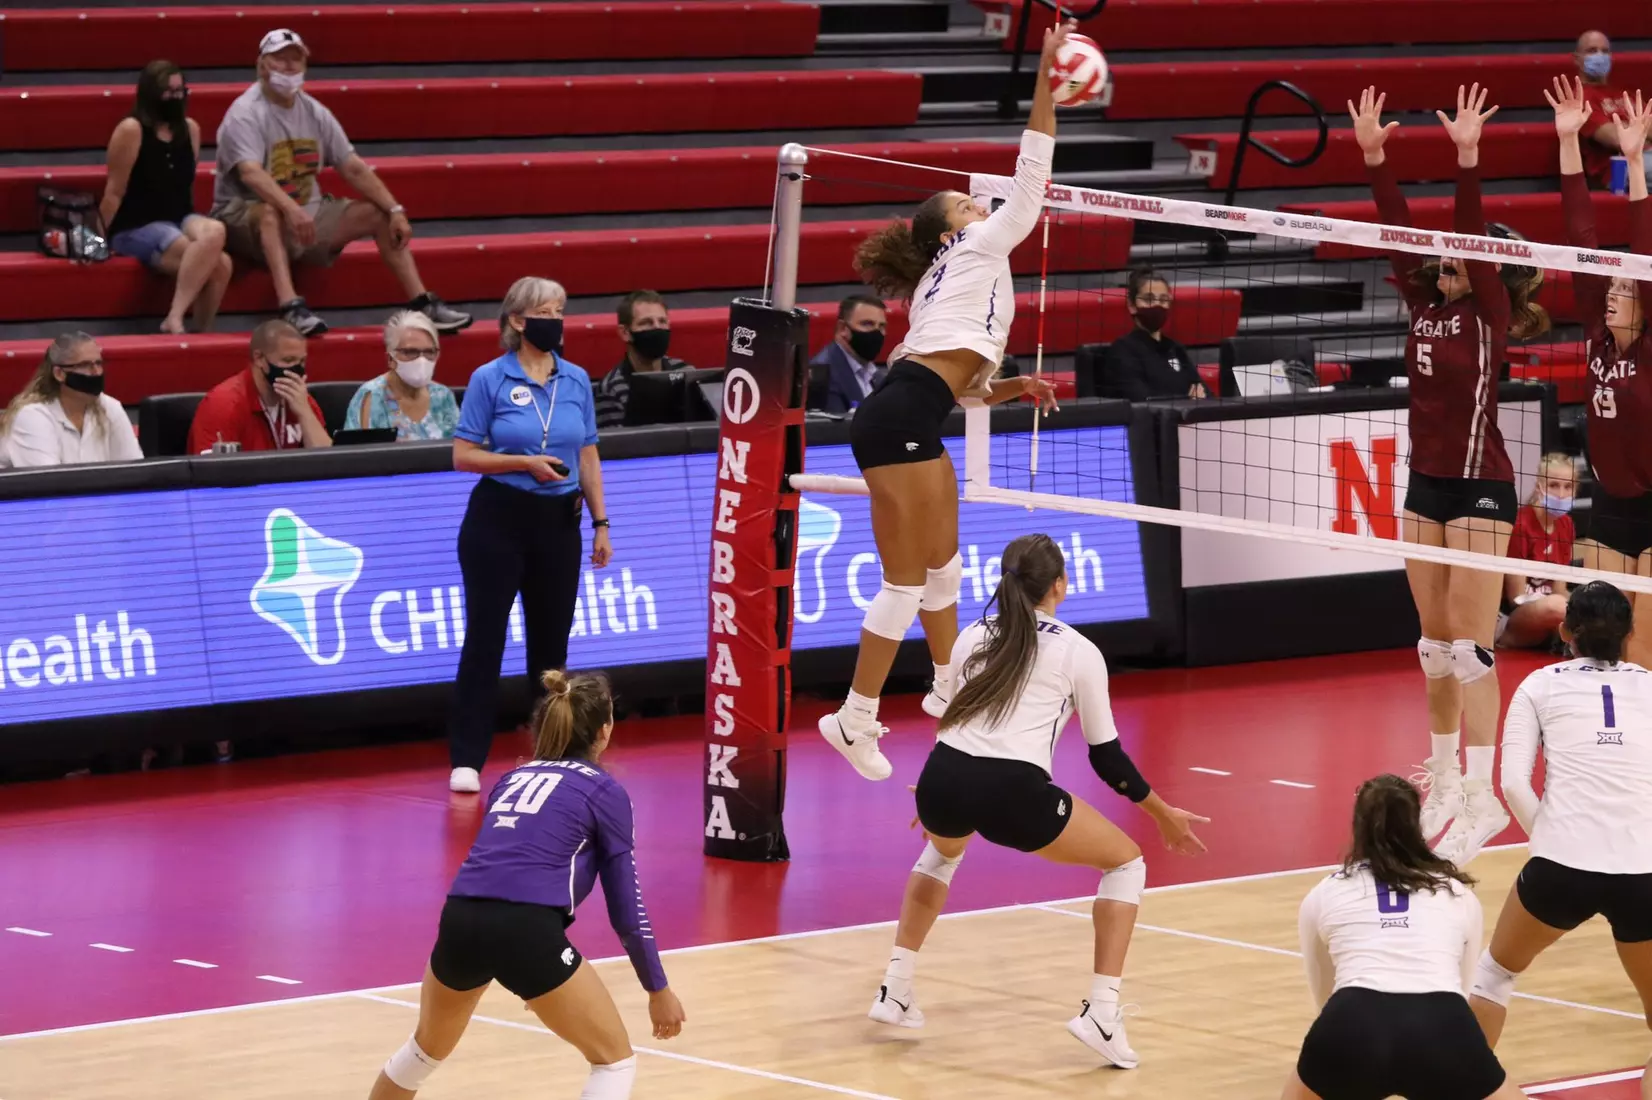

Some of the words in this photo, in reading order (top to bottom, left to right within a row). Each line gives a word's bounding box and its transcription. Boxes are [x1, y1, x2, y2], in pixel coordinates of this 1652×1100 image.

[1081, 191, 1164, 214] VOLLEYBALL
[1205, 208, 1247, 222] BEARDMORE
[1290, 219, 1333, 232] SUBARU
[1380, 228, 1434, 247] HUSKER
[1442, 235, 1532, 258] VOLLEYBALL
[1577, 253, 1622, 267] BEARDMORE
[1417, 343, 1433, 376] 5
[286, 423, 302, 444] N
[1328, 434, 1399, 540] N
[370, 585, 466, 654] CHI
[0, 610, 157, 690] ealth
[704, 436, 751, 840] NEBRASKA
[1601, 684, 1616, 728] 1
[489, 772, 563, 814] 20
